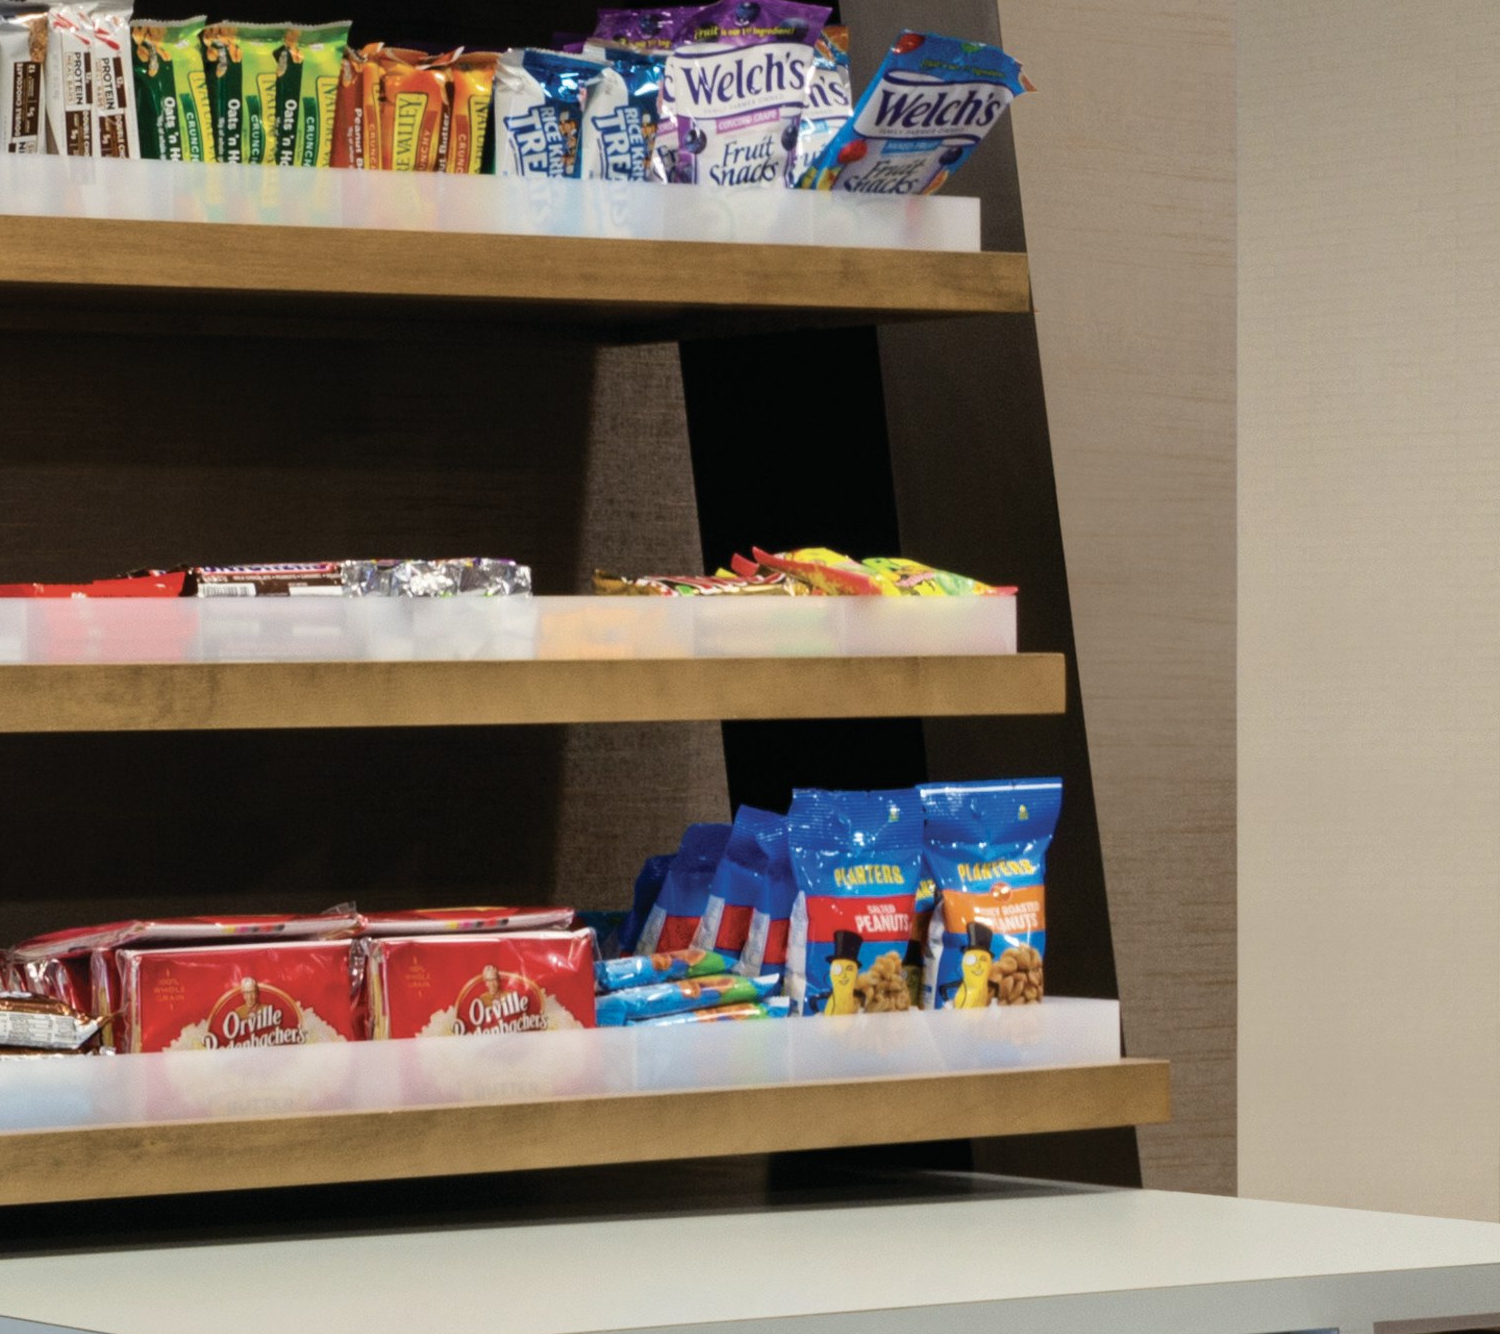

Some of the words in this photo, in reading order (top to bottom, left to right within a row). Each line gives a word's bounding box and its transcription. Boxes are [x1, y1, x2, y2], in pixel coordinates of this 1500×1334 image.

[74, 52, 83, 105] PROTEIN
[101, 57, 115, 110] PROTEIN
[682, 52, 804, 105] Welch's
[164, 96, 176, 129] Oats
[227, 99, 241, 130] Oats
[283, 99, 297, 131] Oats
[397, 98, 422, 153] VALLEY
[874, 90, 1000, 128] Welch's
[354, 107, 363, 153] Peanut
[723, 136, 773, 167] Fruit
[833, 863, 905, 886] PLANTERS
[957, 859, 1034, 883] PLANTERS
[855, 912, 910, 934] PEANUTS
[223, 1005, 284, 1040] Orville
[468, 992, 529, 1026] Orville
